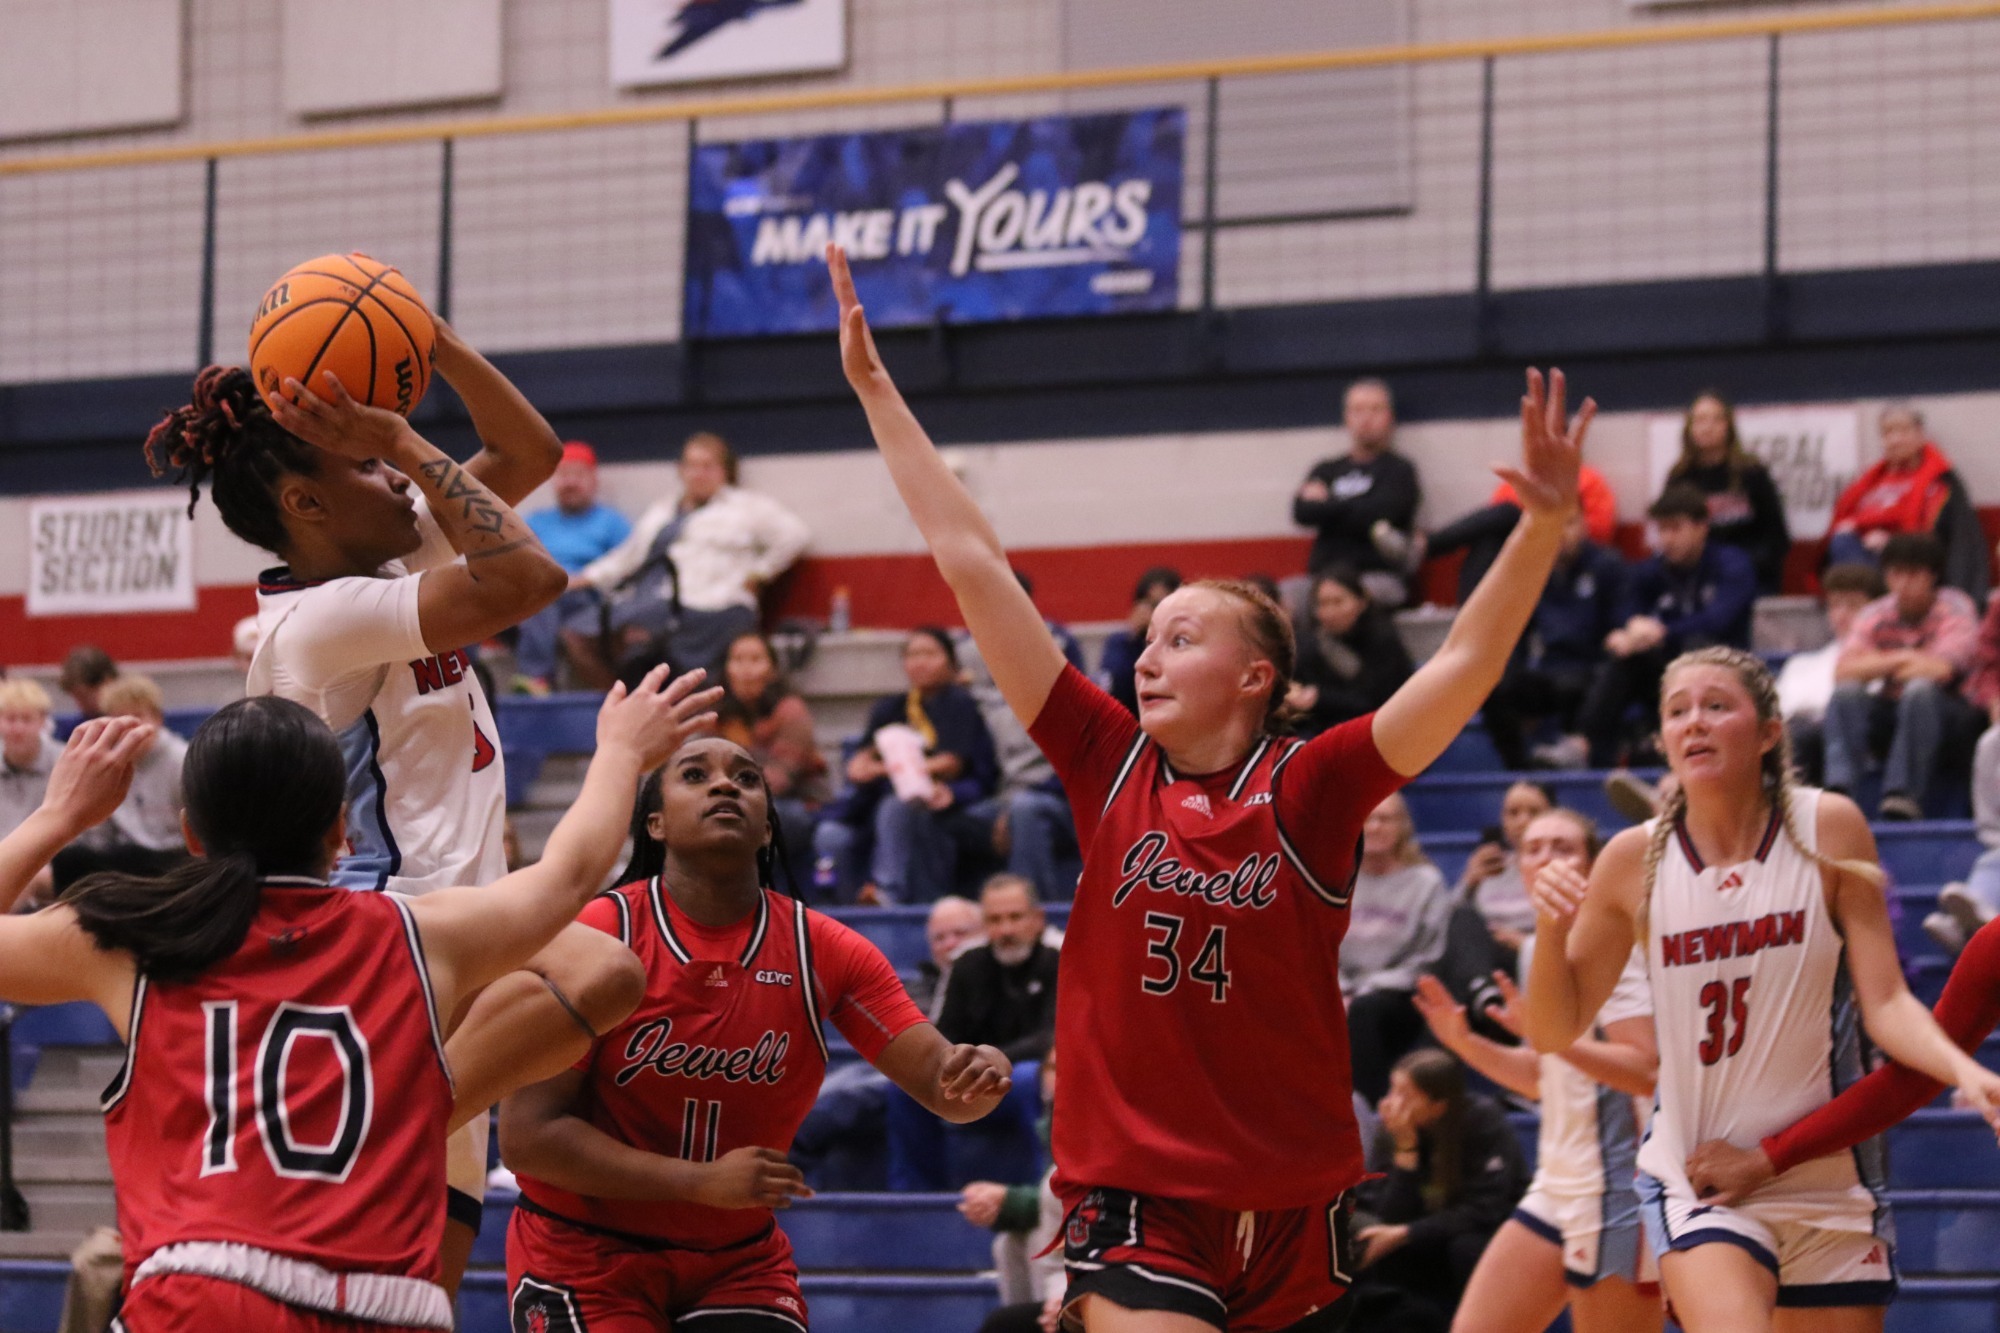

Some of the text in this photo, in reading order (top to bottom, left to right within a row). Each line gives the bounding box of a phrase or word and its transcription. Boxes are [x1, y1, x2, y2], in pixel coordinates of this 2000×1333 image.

[751, 209, 894, 267] MAKE
[897, 203, 947, 257] IT
[36, 507, 182, 551] STUDENT
[40, 552, 180, 596] SECTION
[1180, 797, 1215, 821] adidas
[1112, 829, 1281, 910] Jewell
[1141, 910, 1232, 1003] 34
[1661, 909, 1806, 968] NEWMAN
[755, 970, 793, 986] GLVC
[615, 1017, 790, 1087] Jewell
[1699, 974, 1753, 1067] 35
[199, 1000, 375, 1184] 10
[679, 1097, 722, 1165] 11
